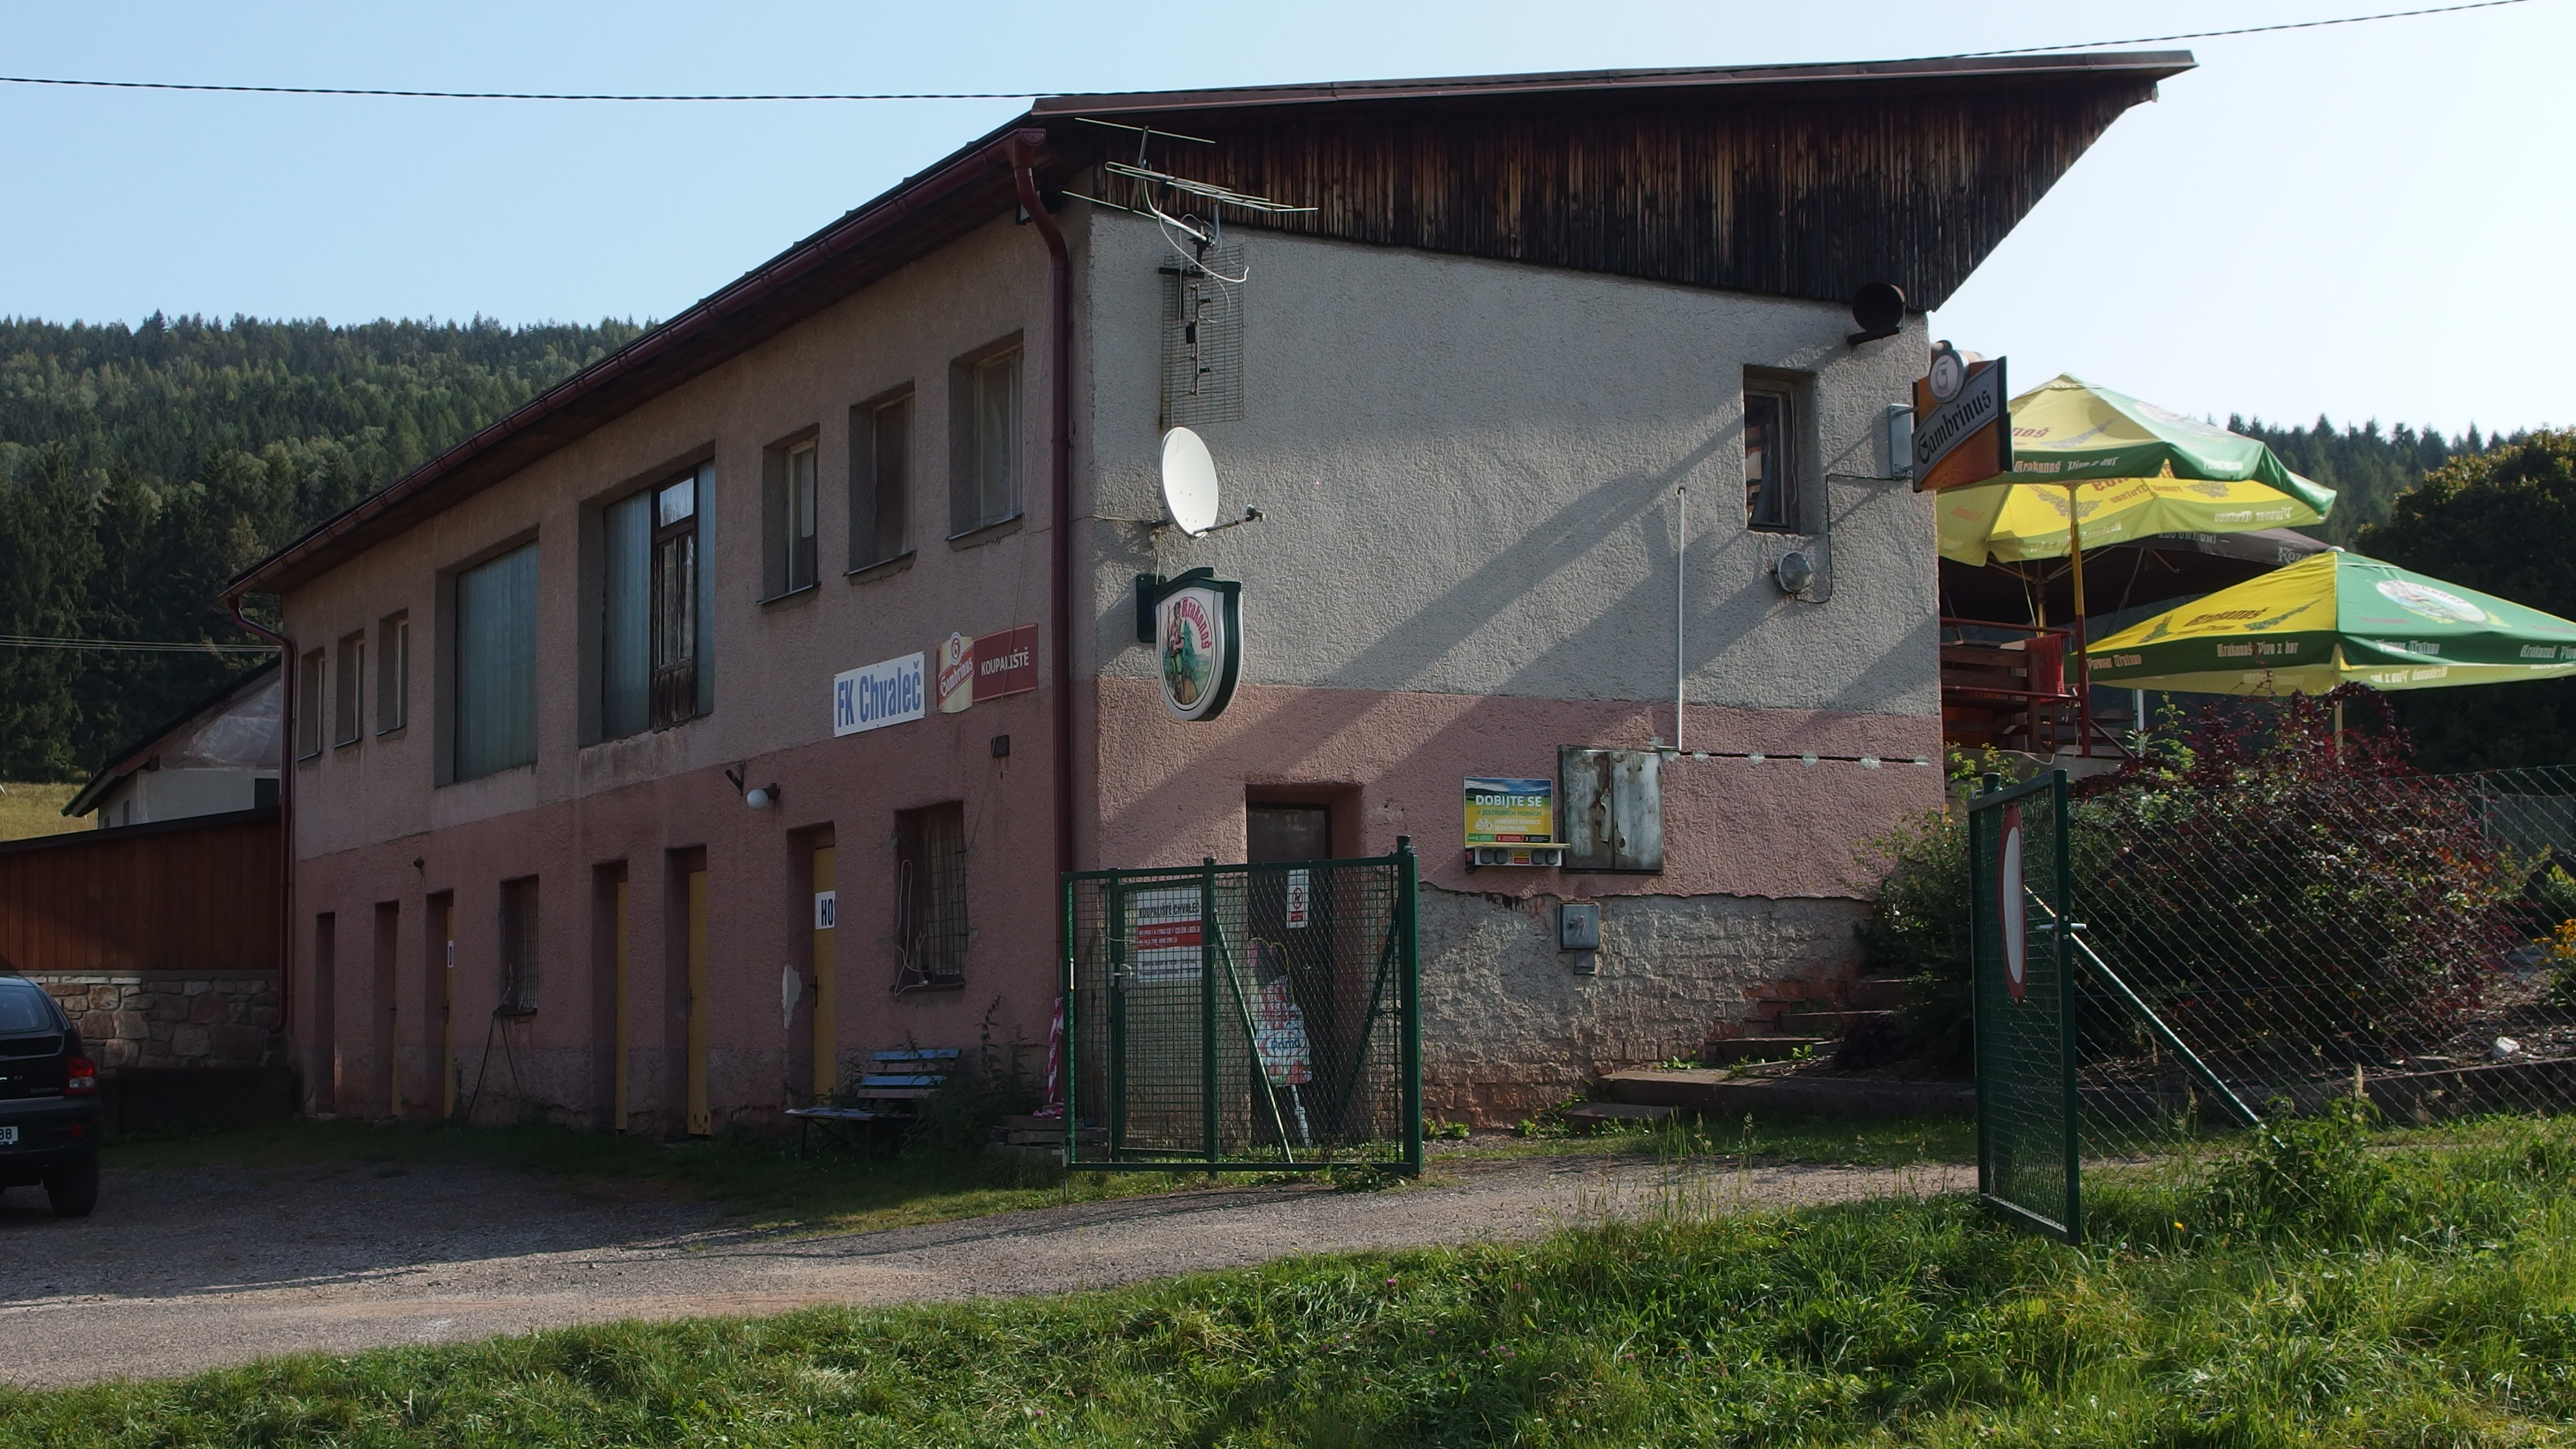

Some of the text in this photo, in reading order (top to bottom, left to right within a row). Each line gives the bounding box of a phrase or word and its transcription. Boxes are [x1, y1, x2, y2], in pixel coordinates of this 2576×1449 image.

[1917, 390, 1992, 465] Gambrinus
[940, 657, 974, 698] Gambrinus
[981, 646, 1030, 676] KOUPALIŠTĚ
[837, 660, 921, 728] FK Chvaleč
[1475, 795, 1542, 808] DOBIJTE SE
[1139, 898, 1200, 918] KOUPALIŠTĚ CHVALEČ
